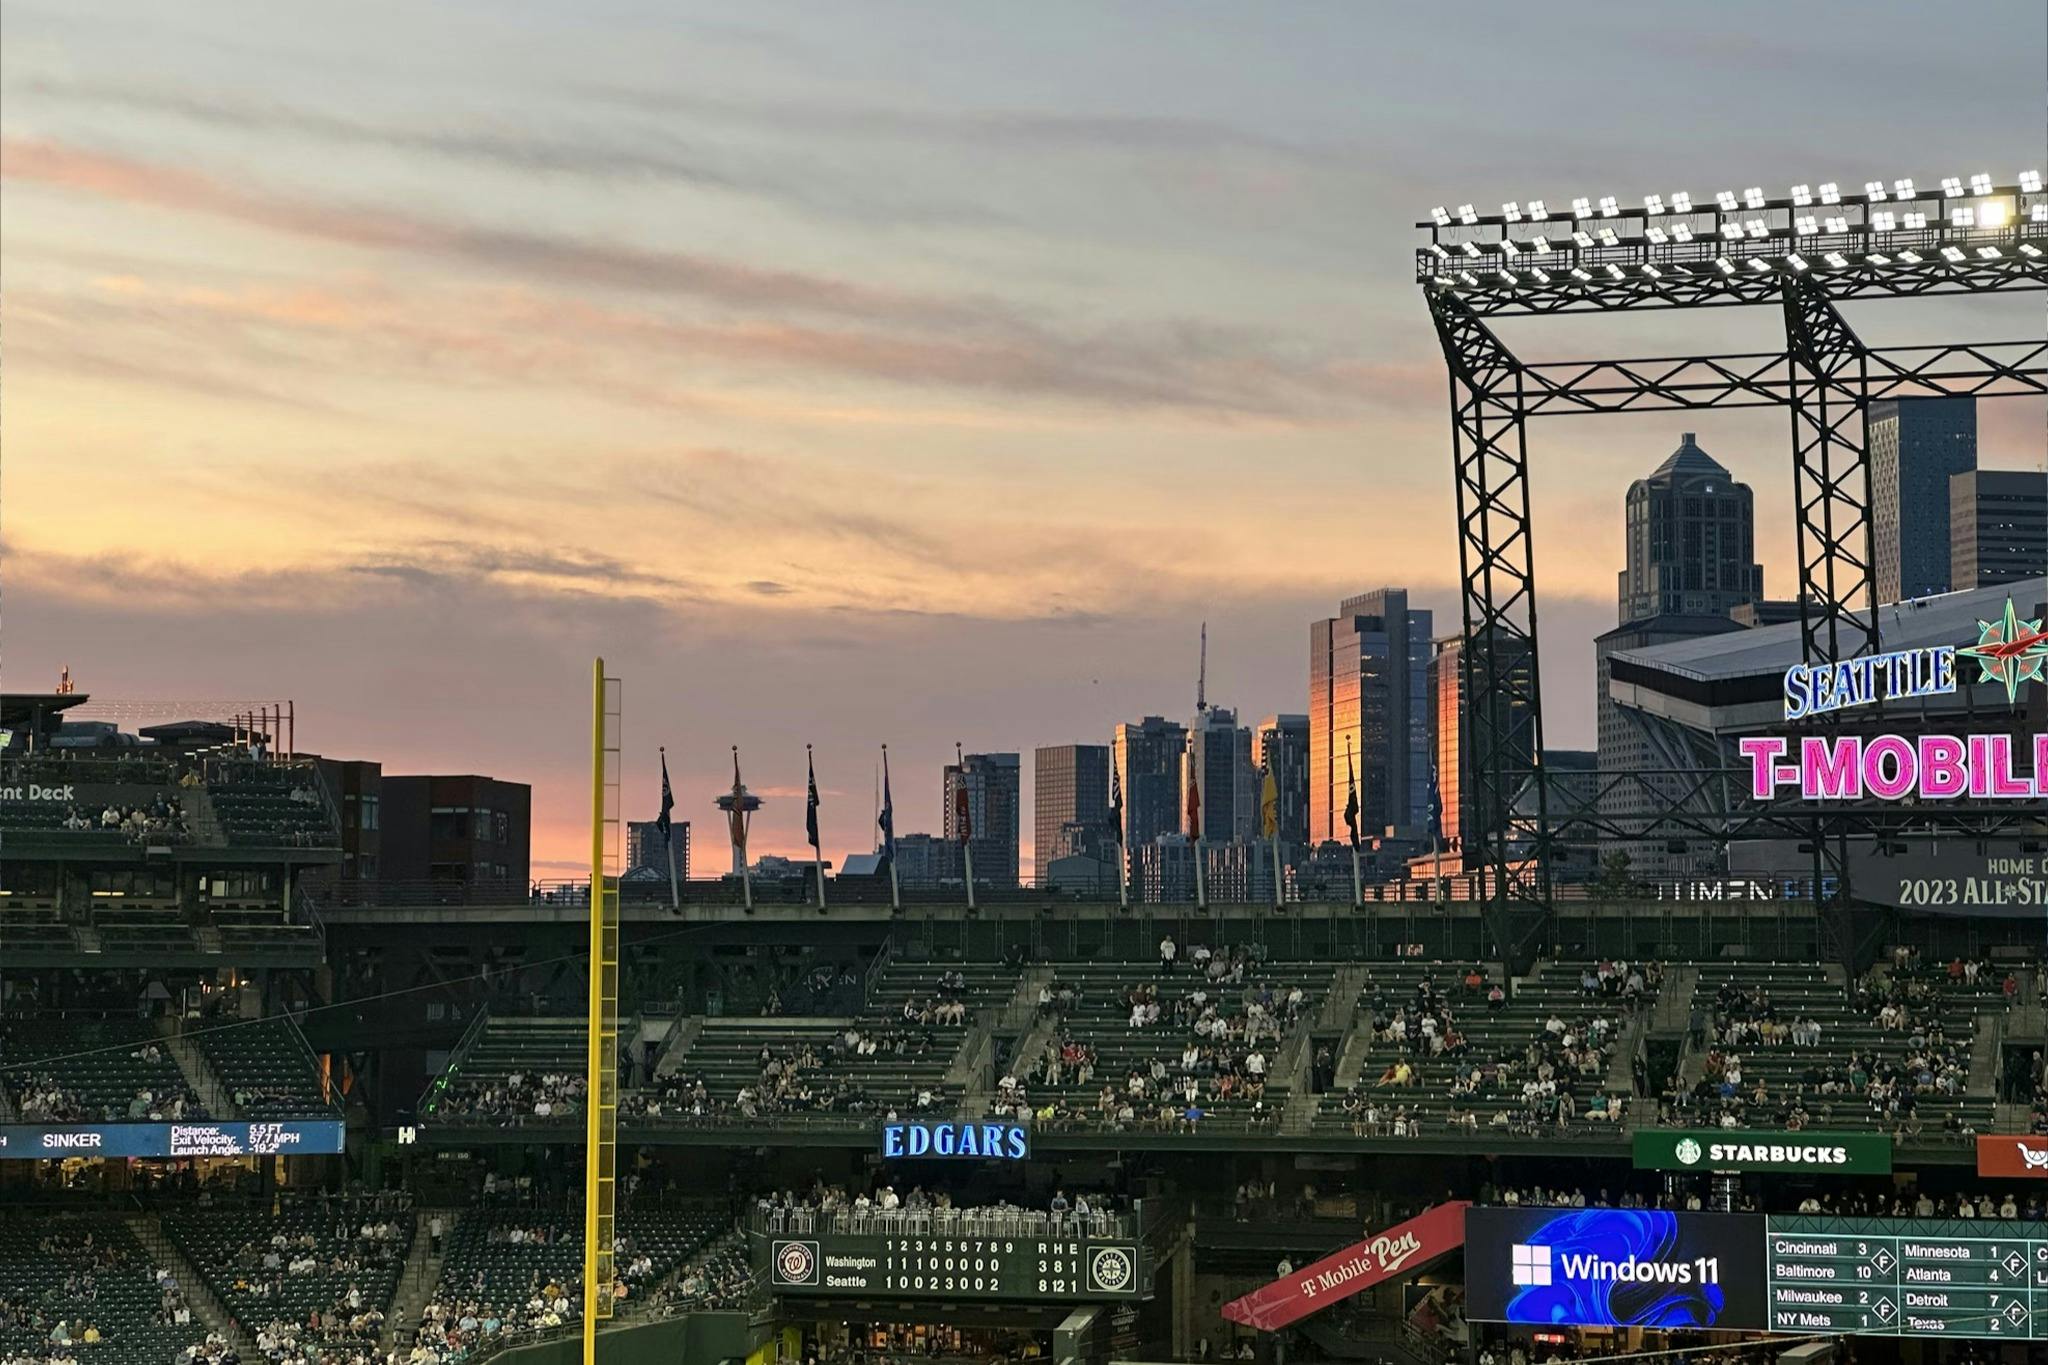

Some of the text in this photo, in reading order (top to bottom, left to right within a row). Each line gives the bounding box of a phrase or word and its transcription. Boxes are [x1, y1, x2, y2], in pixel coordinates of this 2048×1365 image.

[1784, 646, 1956, 721] SEATTLE
[29, 784, 74, 800] Deck
[1988, 858, 2034, 875] HOME
[1900, 879, 1959, 905] 2023
[171, 1126, 219, 1136] Distance:
[250, 1124, 283, 1134] 5.5 FT
[43, 1134, 101, 1147] SINKER
[171, 1135, 236, 1147] Exit Velocity:
[250, 1133, 300, 1144] 57.7 MPH
[885, 1124, 1026, 1159] EDGAR'S
[171, 1144, 243, 1156] Launch Angle:
[1709, 1144, 1847, 1164] STARBUCKS
[886, 1240, 1078, 1255] 1 2 3 4 5 6 7 8 9 R H E
[1775, 1241, 1867, 1256] Cincinnati 3
[1904, 1244, 1997, 1259] Minnesota 1
[826, 1256, 1077, 1274] Washington 1 1 1 0 0 0 0 0 3 8 1
[1561, 1253, 1719, 1284] Windows 11
[1879, 1255, 1889, 1269] F
[2009, 1258, 2020, 1272] F
[1316, 1257, 1372, 1291] Mobile
[1775, 1264, 1872, 1279] Baltimore 10
[1906, 1267, 1999, 1282] Atlanta 4
[826, 1275, 1077, 1293] Seattle 1 0 0 2 3 0 0 2 8 12 1
[1776, 1289, 1869, 1304] Milwaukee 2
[1905, 1293, 1999, 1308] Detroit 7
[1880, 1304, 1890, 1318] F
[1777, 1312, 1868, 1327] NY Mets 1
[1907, 1317, 2000, 1331] Texas 2
